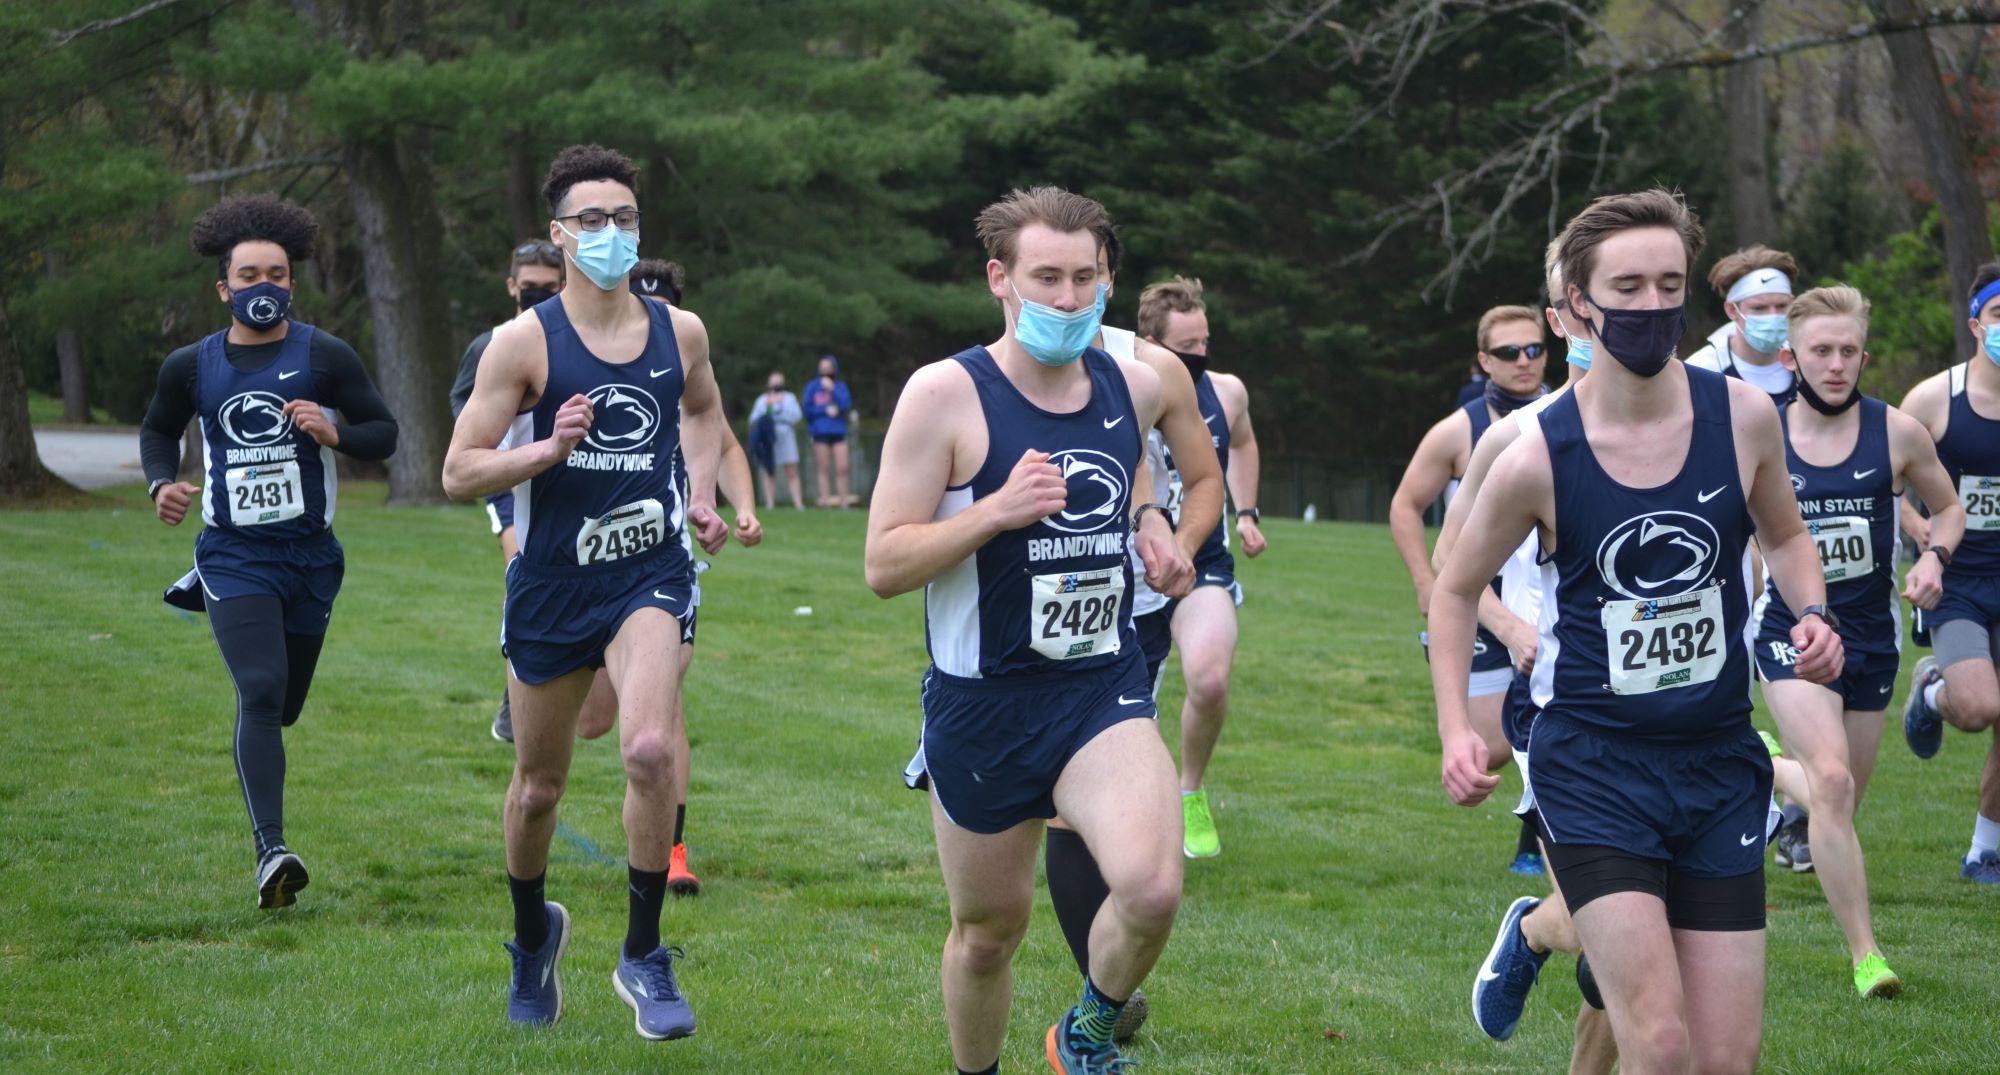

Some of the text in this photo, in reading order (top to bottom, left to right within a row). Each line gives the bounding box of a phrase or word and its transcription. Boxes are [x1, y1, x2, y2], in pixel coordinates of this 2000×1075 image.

[225, 444, 298, 464] BRANDYWINE
[566, 449, 655, 471] BRANDYWINE
[235, 480, 294, 510] 2431
[1798, 498, 1873, 514] NN STATE
[585, 519, 658, 564] 2435
[1028, 532, 1123, 561] BRANDYWINE
[1817, 535, 1865, 566] 440
[1042, 594, 1117, 639] 2428
[1620, 617, 1717, 670] 2432
[1663, 671, 1690, 680] NOLAN
